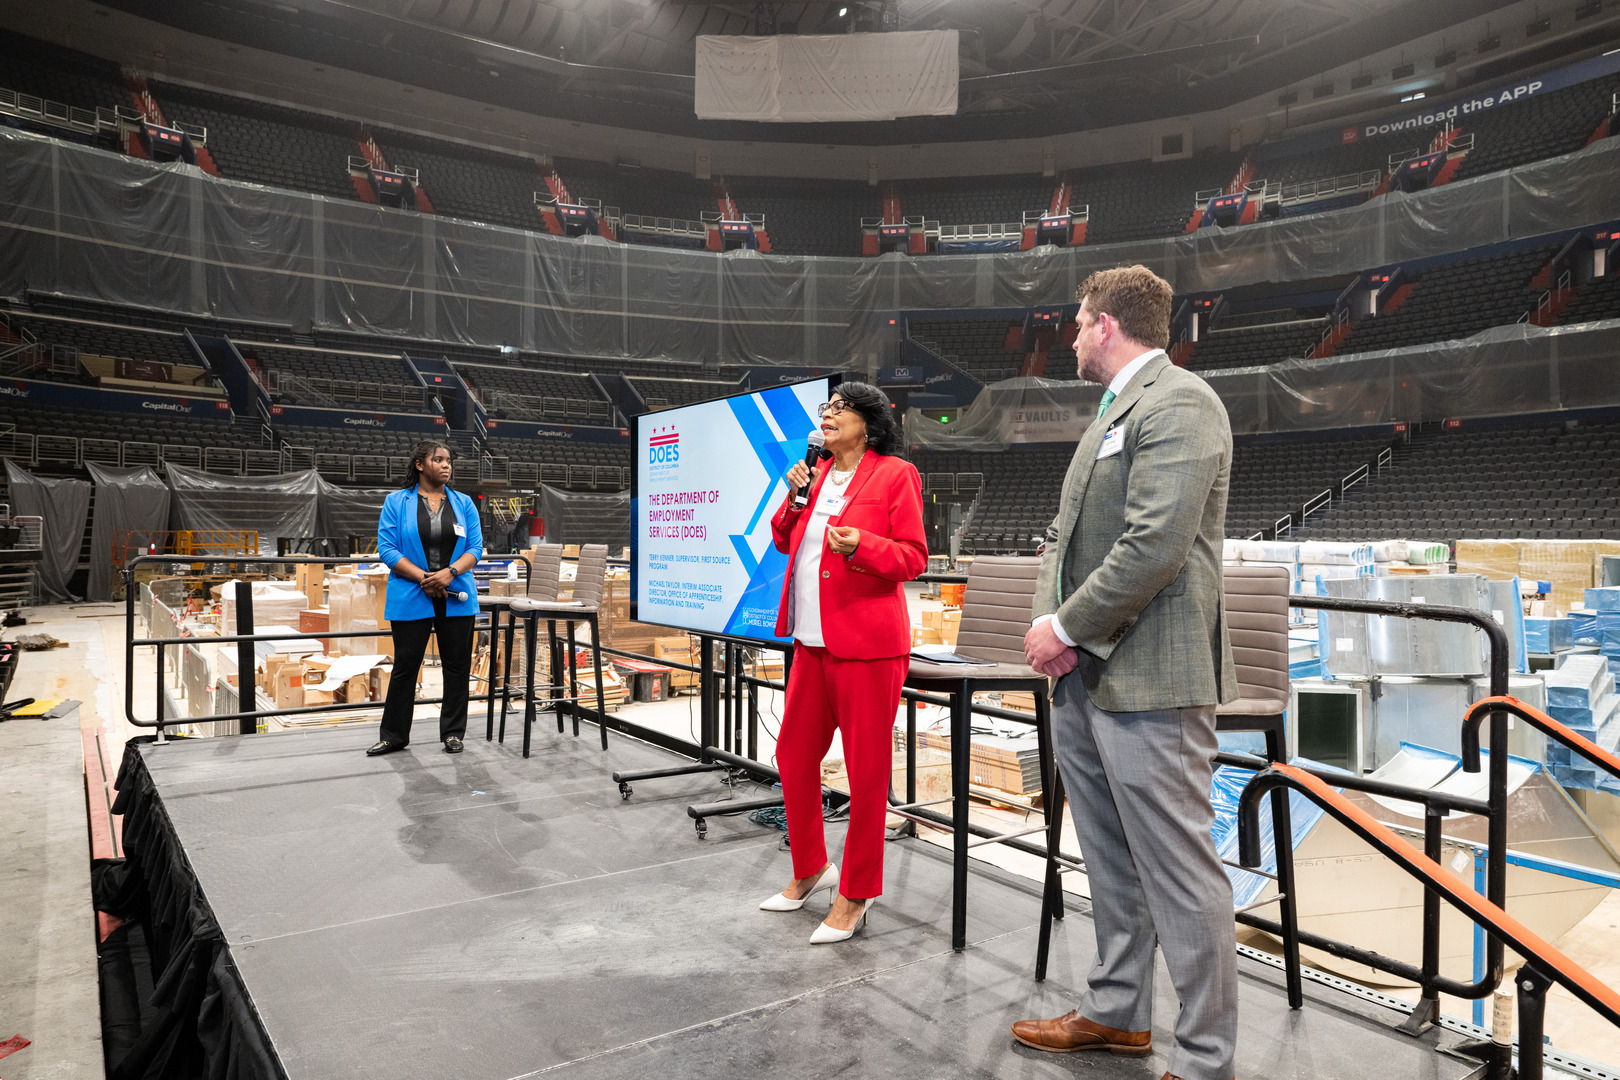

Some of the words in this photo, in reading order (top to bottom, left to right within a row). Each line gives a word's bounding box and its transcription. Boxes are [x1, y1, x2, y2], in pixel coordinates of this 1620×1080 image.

[1365, 106, 1457, 137] Download
[1462, 97, 1494, 115] the
[1498, 81, 1543, 104] APP
[1025, 410, 1070, 422] VAULTS
[650, 444, 679, 464] DOES
[649, 494, 660, 506] THE
[661, 491, 706, 505] DEPARTMENT
[708, 490, 719, 504] OF
[649, 509, 694, 522] EMPLOYMENT
[649, 526, 680, 538] SERVICES
[681, 525, 707, 542] (DOES)
[649, 562, 668, 570] PROGRAM
[701, 556, 712, 564] FIRST
[712, 556, 731, 565] SOURCE
[649, 580, 665, 588] MICHAEL
[682, 582, 697, 590] INTERIM
[698, 584, 722, 593] ASSOCIATE
[668, 590, 682, 598] OFFICE
[682, 591, 688, 599] OF
[649, 597, 675, 606] INFORMATION
[675, 600, 684, 608] AND
[685, 601, 704, 610] TRAINING
[749, 619, 762, 627] MURIEL
[763, 620, 777, 628] BOWSE
